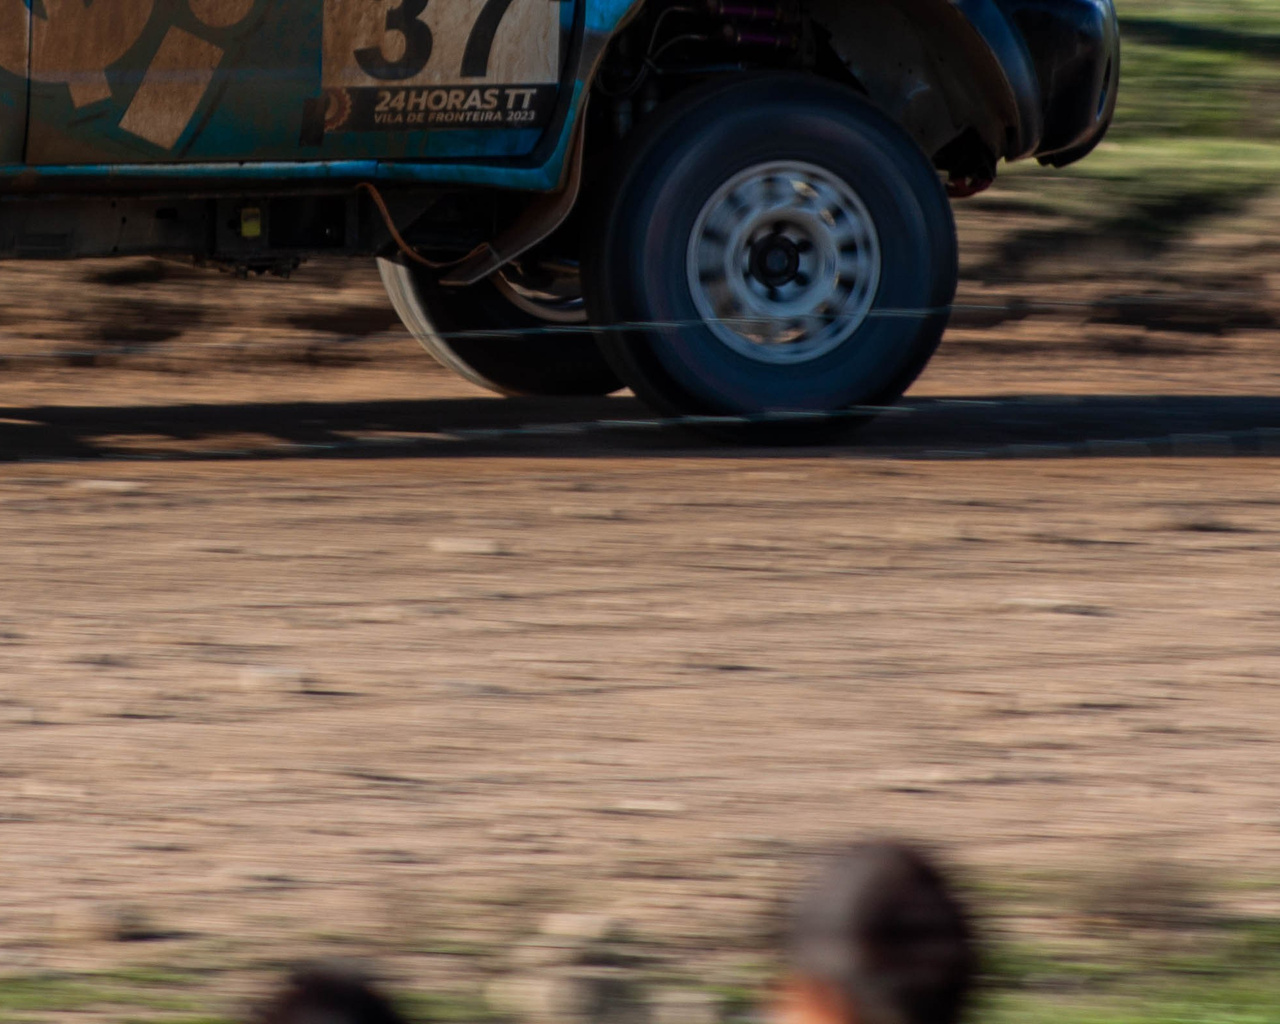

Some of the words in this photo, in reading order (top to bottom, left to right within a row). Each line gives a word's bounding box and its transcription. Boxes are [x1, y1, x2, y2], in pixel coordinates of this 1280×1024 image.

[504, 88, 537, 110] TT
[374, 112, 404, 124] VILA
[407, 112, 425, 124] DE
[428, 111, 502, 123] FRONTEIRA
[506, 110, 536, 122] 2023
